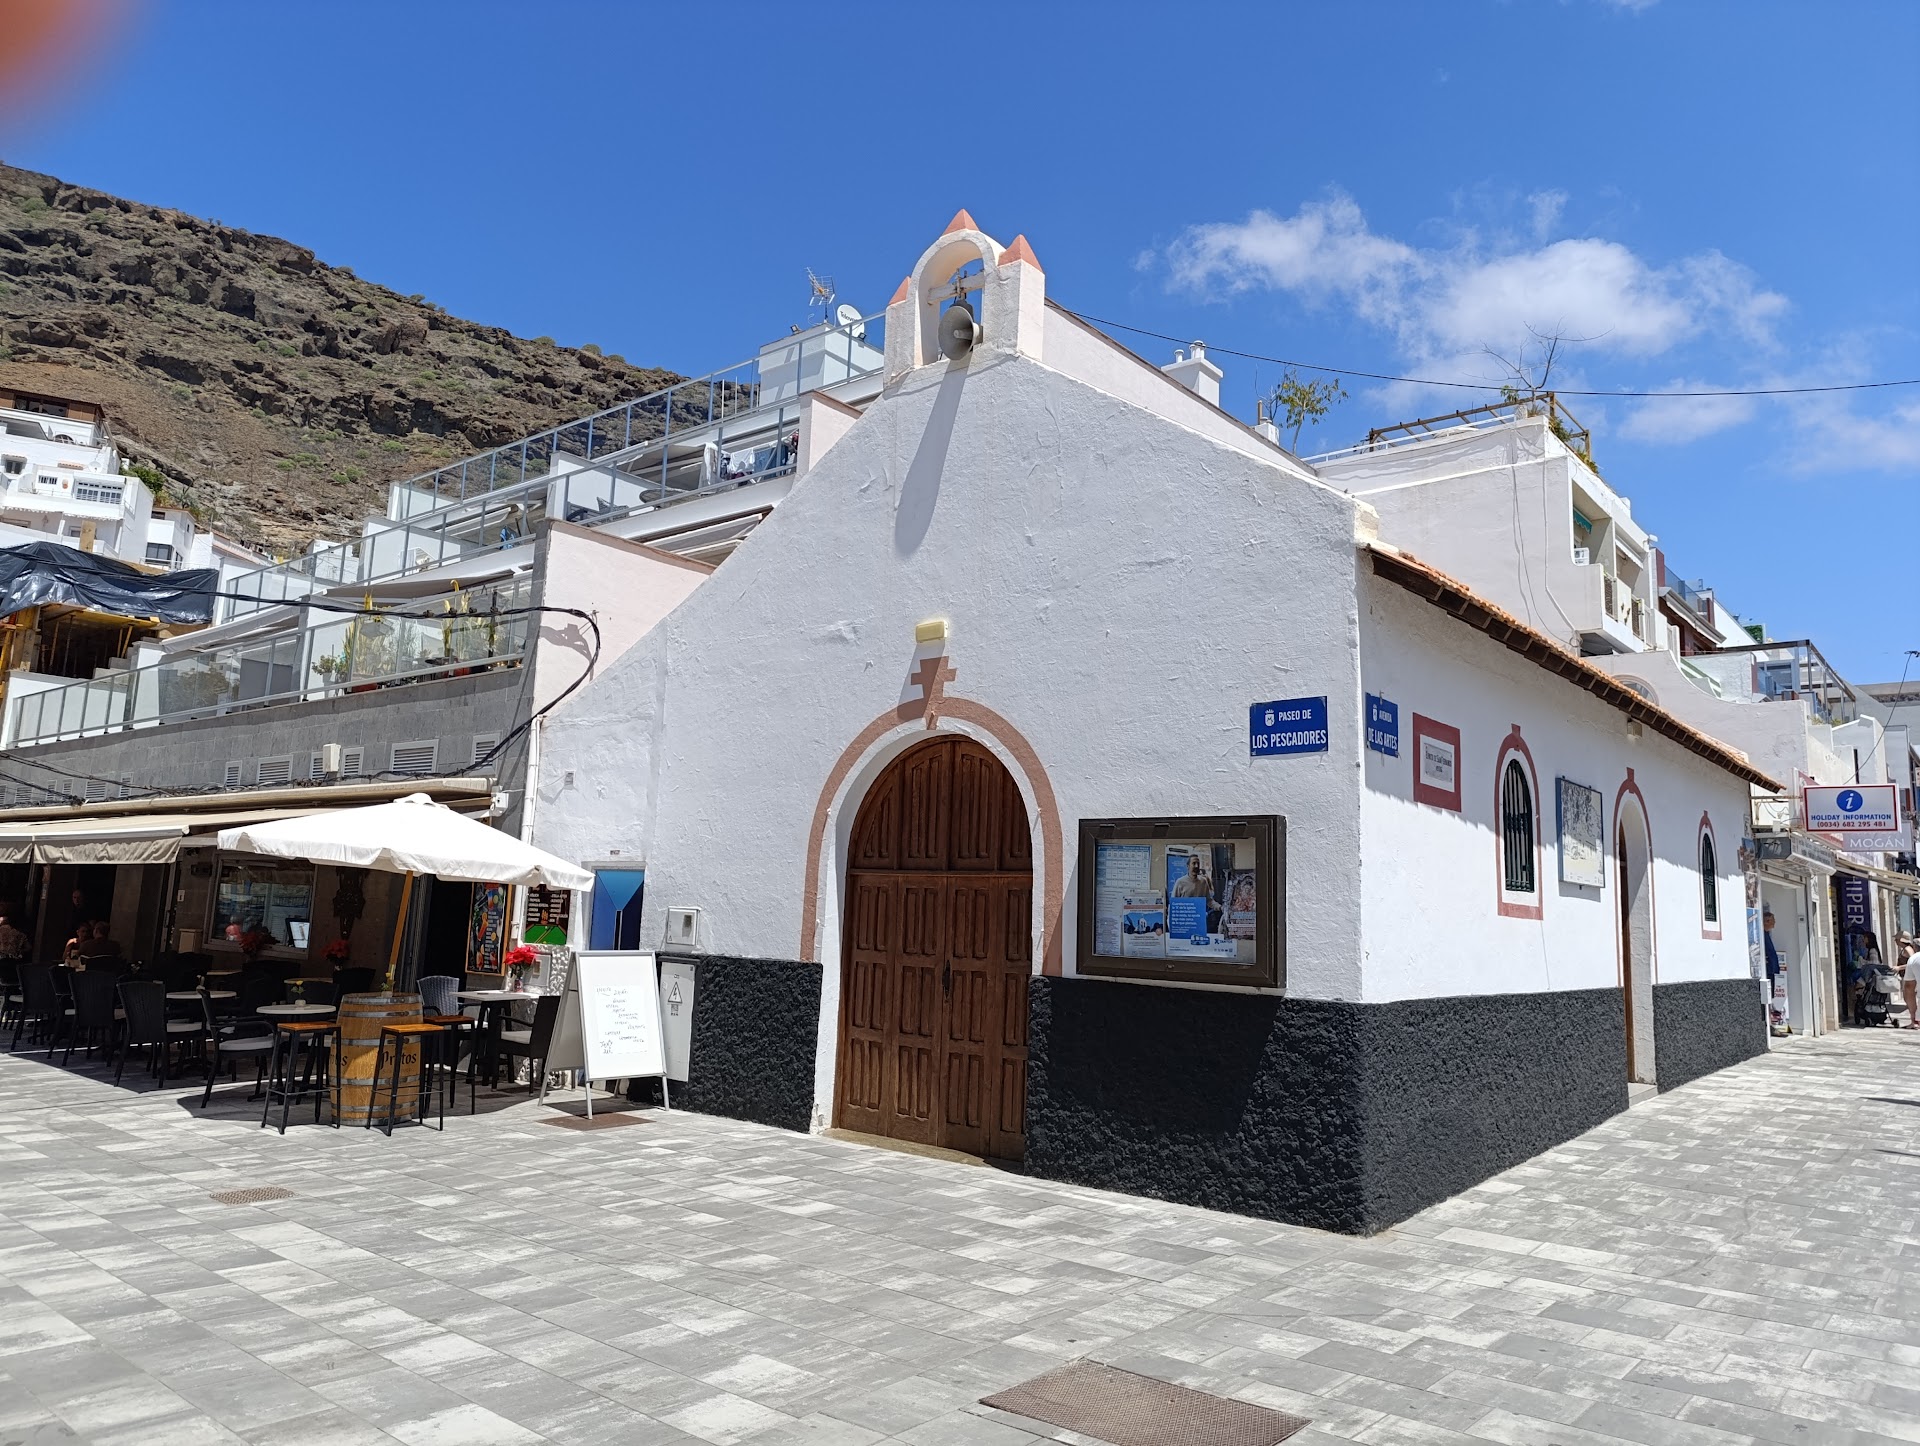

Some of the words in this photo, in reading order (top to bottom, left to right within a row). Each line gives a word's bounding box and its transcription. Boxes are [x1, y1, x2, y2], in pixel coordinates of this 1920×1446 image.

[1278, 710, 1300, 721] PASEO
[1302, 709, 1312, 719] DE
[1252, 734, 1268, 748] LOS
[1270, 729, 1327, 747] PESCADORES
[1367, 727, 1374, 742] DE
[1375, 730, 1383, 745] LAS
[1384, 732, 1398, 749] ARTES
[1850, 835, 1905, 848] MOGÁN
[380, 1050, 417, 1070] Prtos
